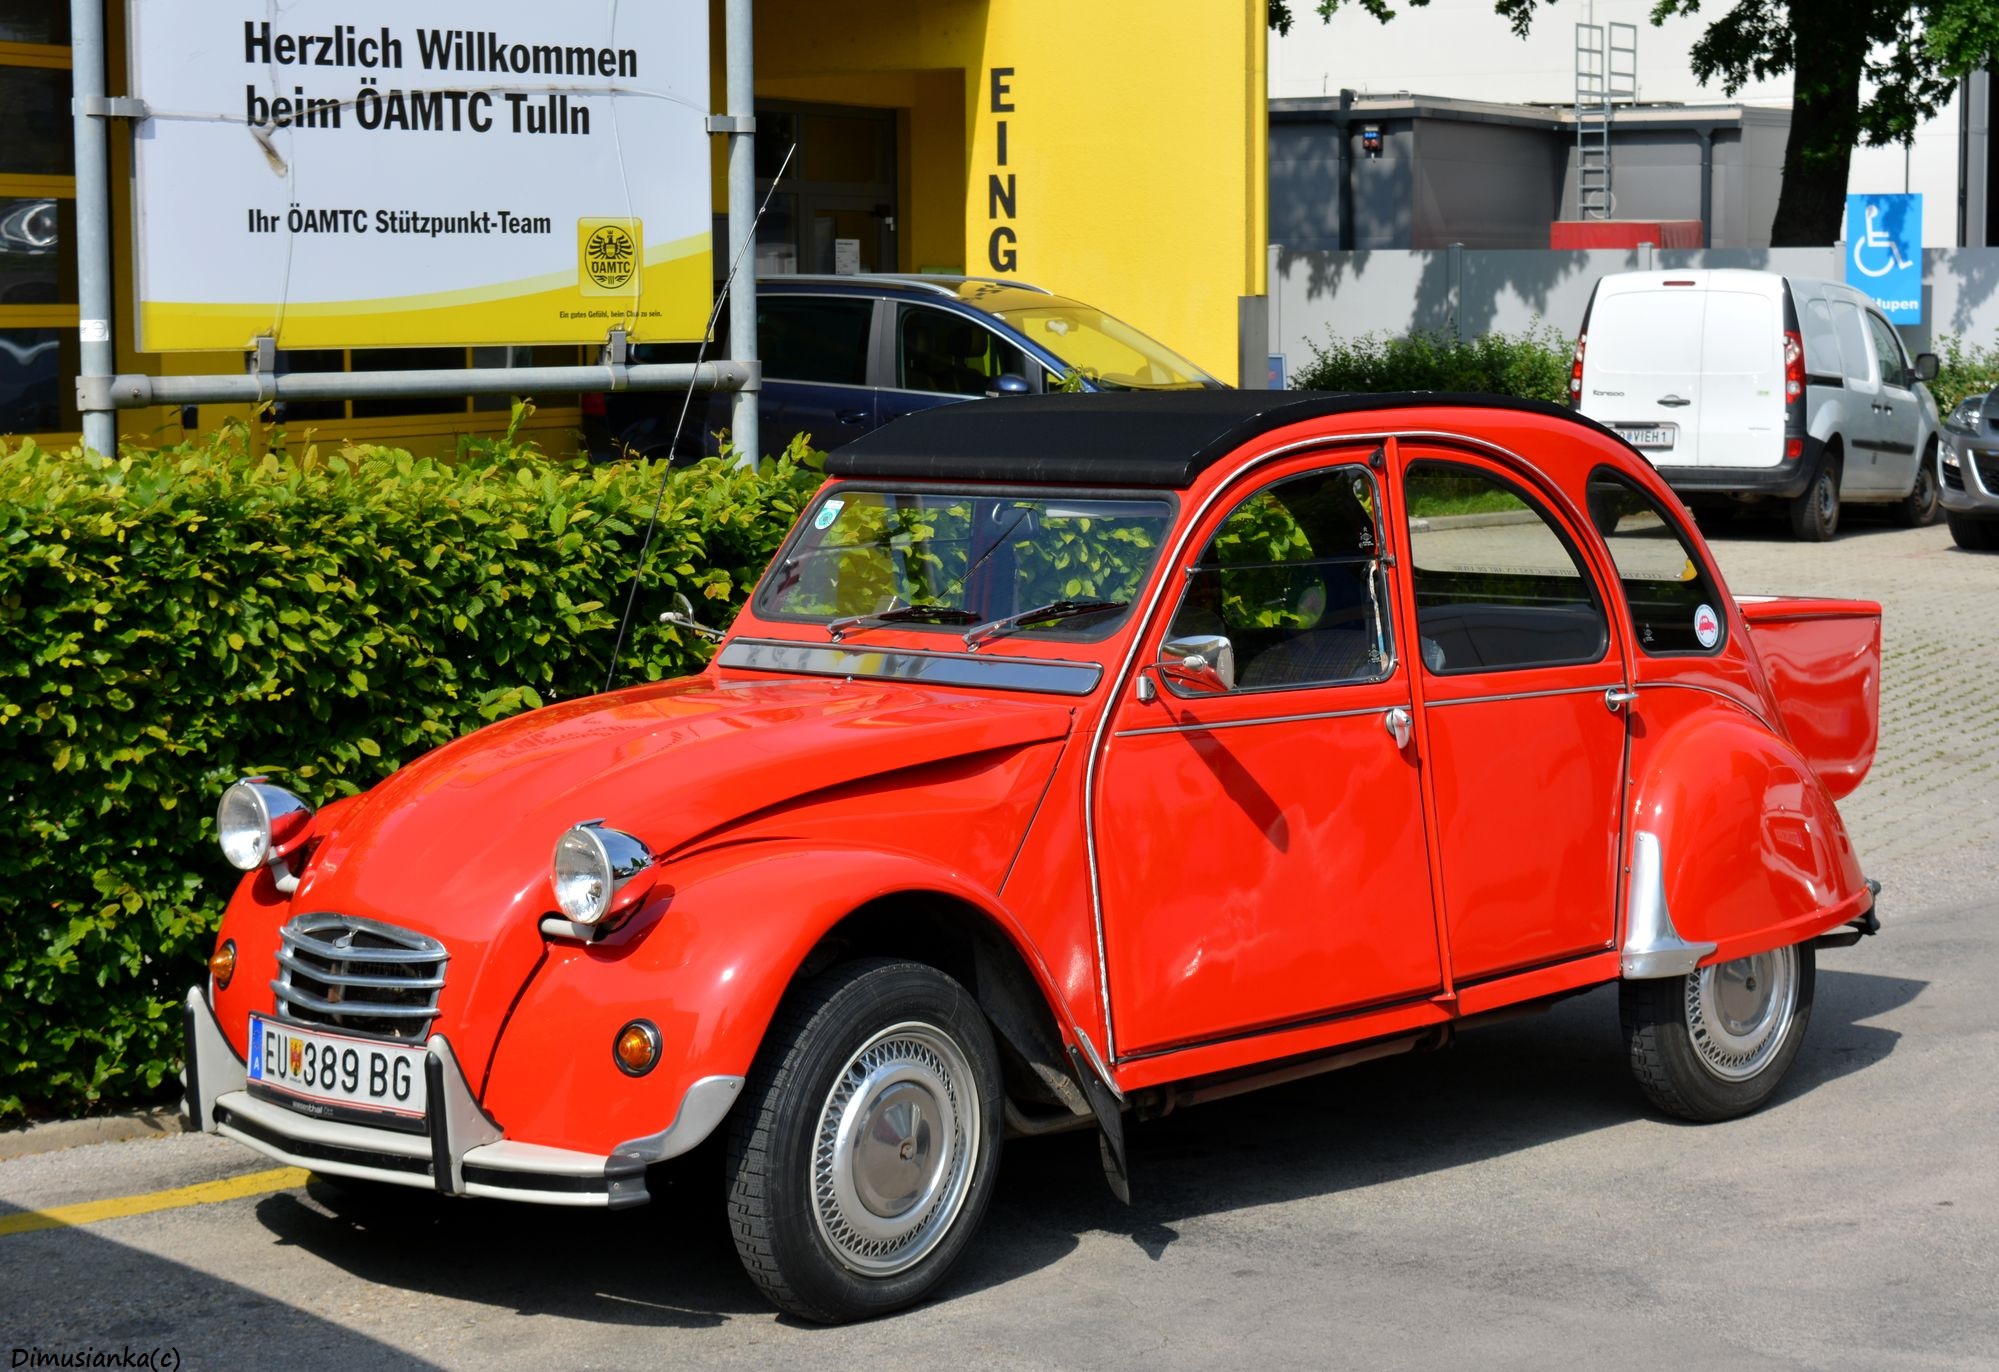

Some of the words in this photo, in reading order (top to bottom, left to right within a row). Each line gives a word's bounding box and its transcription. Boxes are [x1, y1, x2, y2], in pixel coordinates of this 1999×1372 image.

[244, 21, 402, 68] Herzlich
[416, 28, 637, 78] Willkommen
[246, 84, 341, 129] beim
[356, 77, 493, 133] ÖAMTC
[505, 93, 590, 135] Tulln
[988, 67, 1017, 273] EING
[248, 208, 280, 233] Ihr
[287, 202, 368, 233] ÖAMTC
[375, 209, 551, 238] Stützpunkt-Team
[591, 260, 631, 274] ÖAMTC
[559, 311, 569, 319] Ein
[611, 310, 625, 318] beim
[1633, 430, 1659, 443] VIEH
[253, 1056, 260, 1071] A
[266, 1030, 288, 1079] EU
[304, 1041, 359, 1094] 389
[369, 1052, 411, 1102] BG
